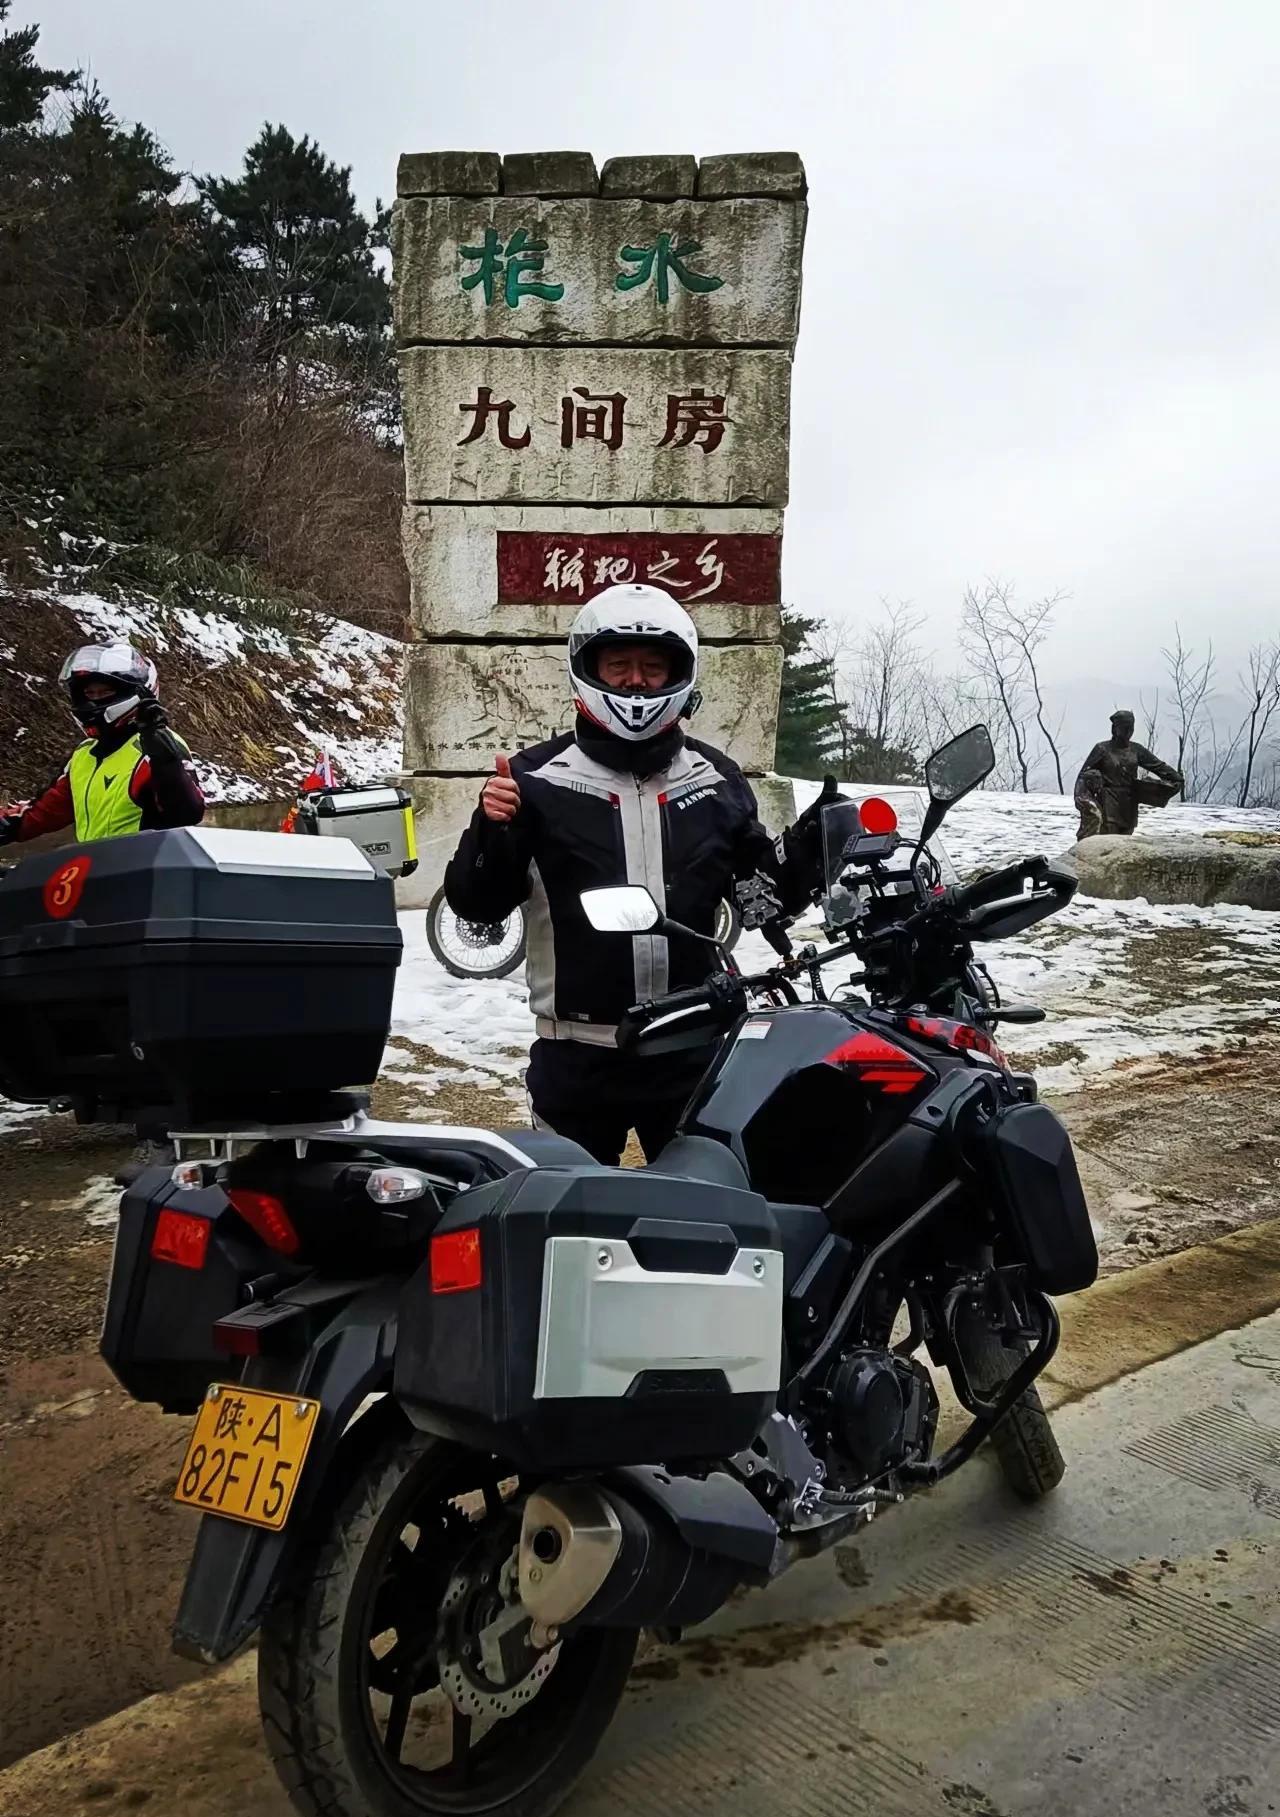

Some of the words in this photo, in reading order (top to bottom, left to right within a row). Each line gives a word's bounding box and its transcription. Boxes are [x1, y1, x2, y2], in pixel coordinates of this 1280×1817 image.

[456, 227, 726, 309] 柞水
[455, 386, 734, 455] 九间房
[53, 866, 79, 905] 3
[182, 1443, 293, 1519] 82F15
